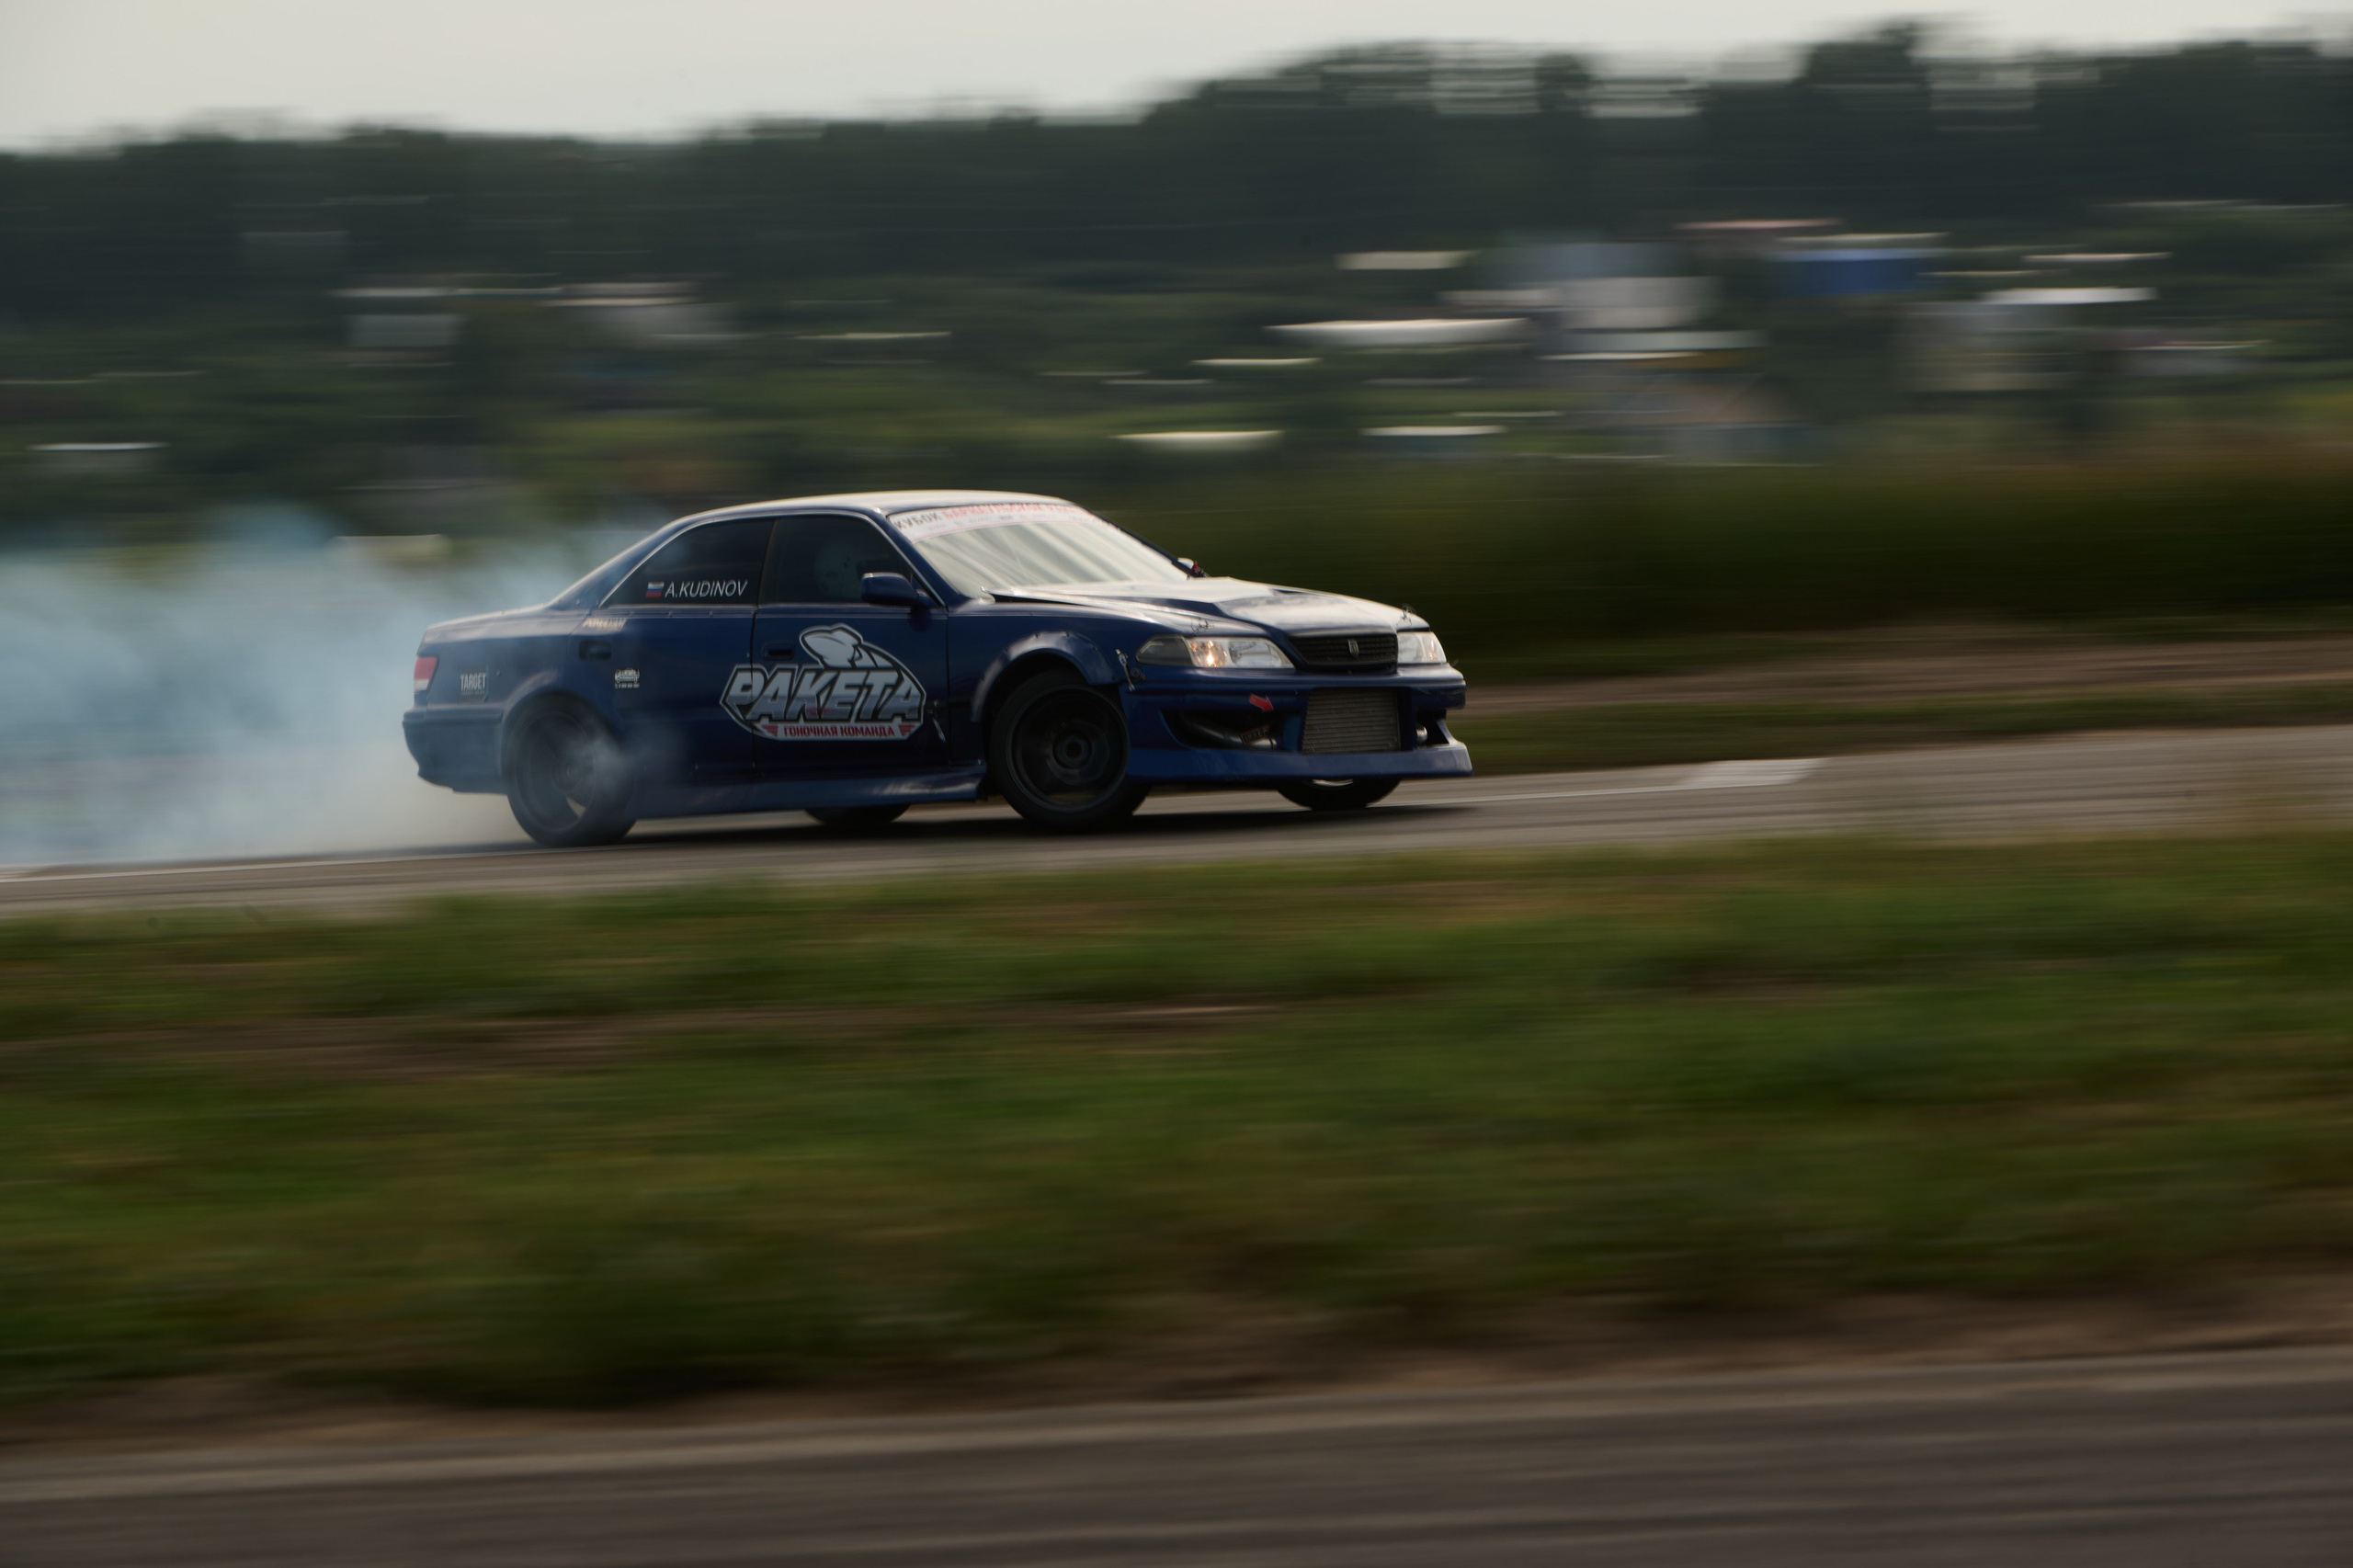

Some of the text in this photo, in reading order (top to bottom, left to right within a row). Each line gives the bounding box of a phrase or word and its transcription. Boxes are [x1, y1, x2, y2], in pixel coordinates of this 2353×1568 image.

[893, 511, 943, 530] КУБОК
[665, 580, 748, 597] A.KUDINOV
[460, 673, 487, 690] TARGET
[783, 725, 895, 737] ГОНОЧНАЯ КОМАНДА
